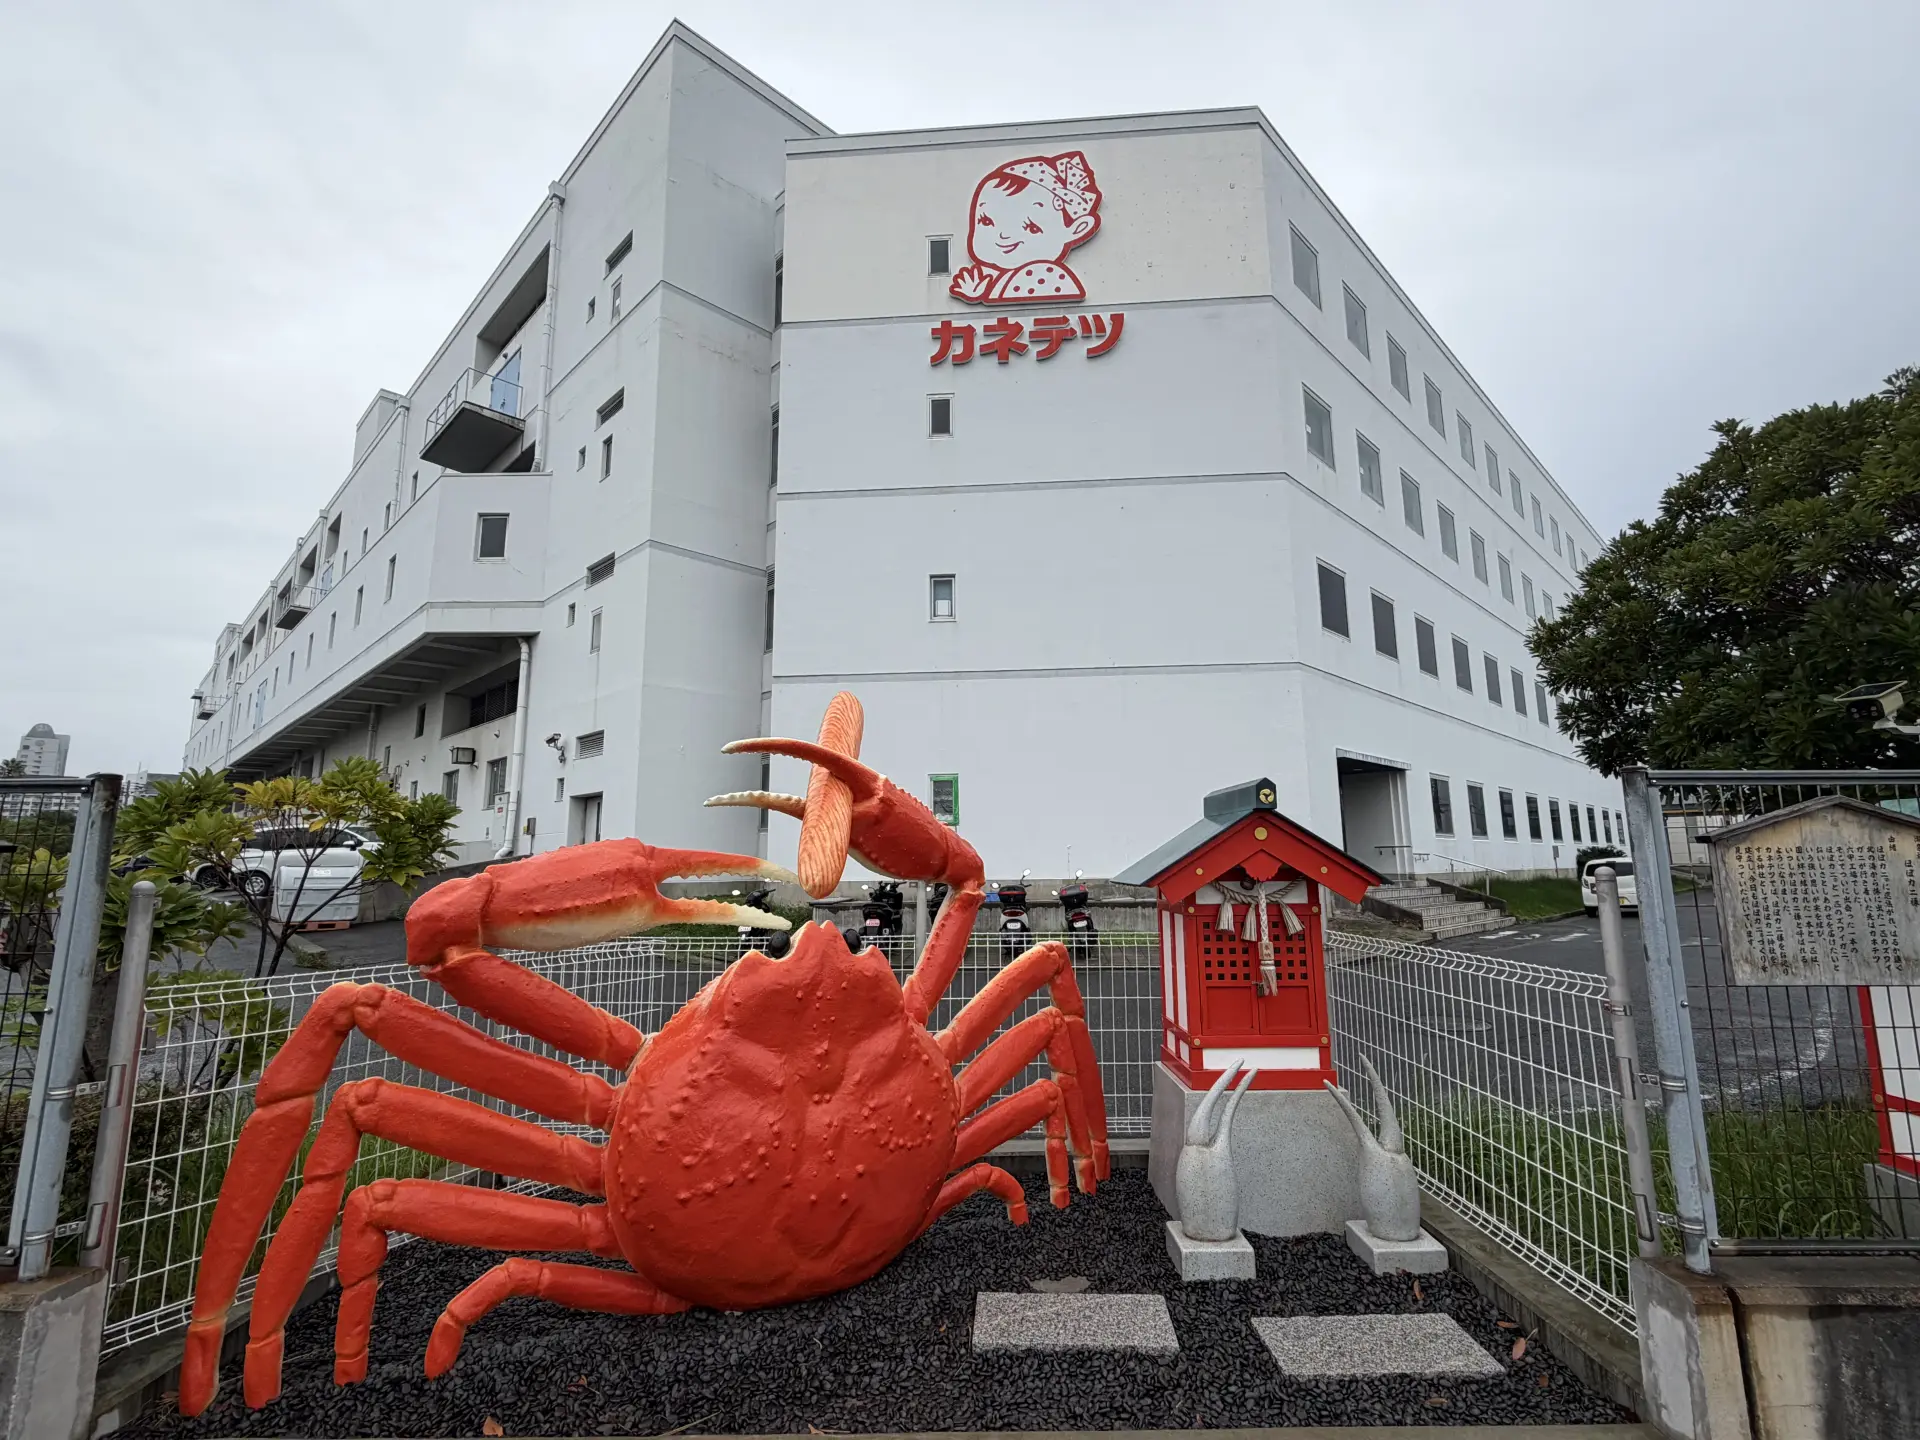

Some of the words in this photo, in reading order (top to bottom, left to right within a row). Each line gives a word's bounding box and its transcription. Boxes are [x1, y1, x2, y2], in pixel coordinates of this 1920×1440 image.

[930, 313, 1125, 366] カネテツ
[1904, 860, 1920, 908] ほぼカニ様
